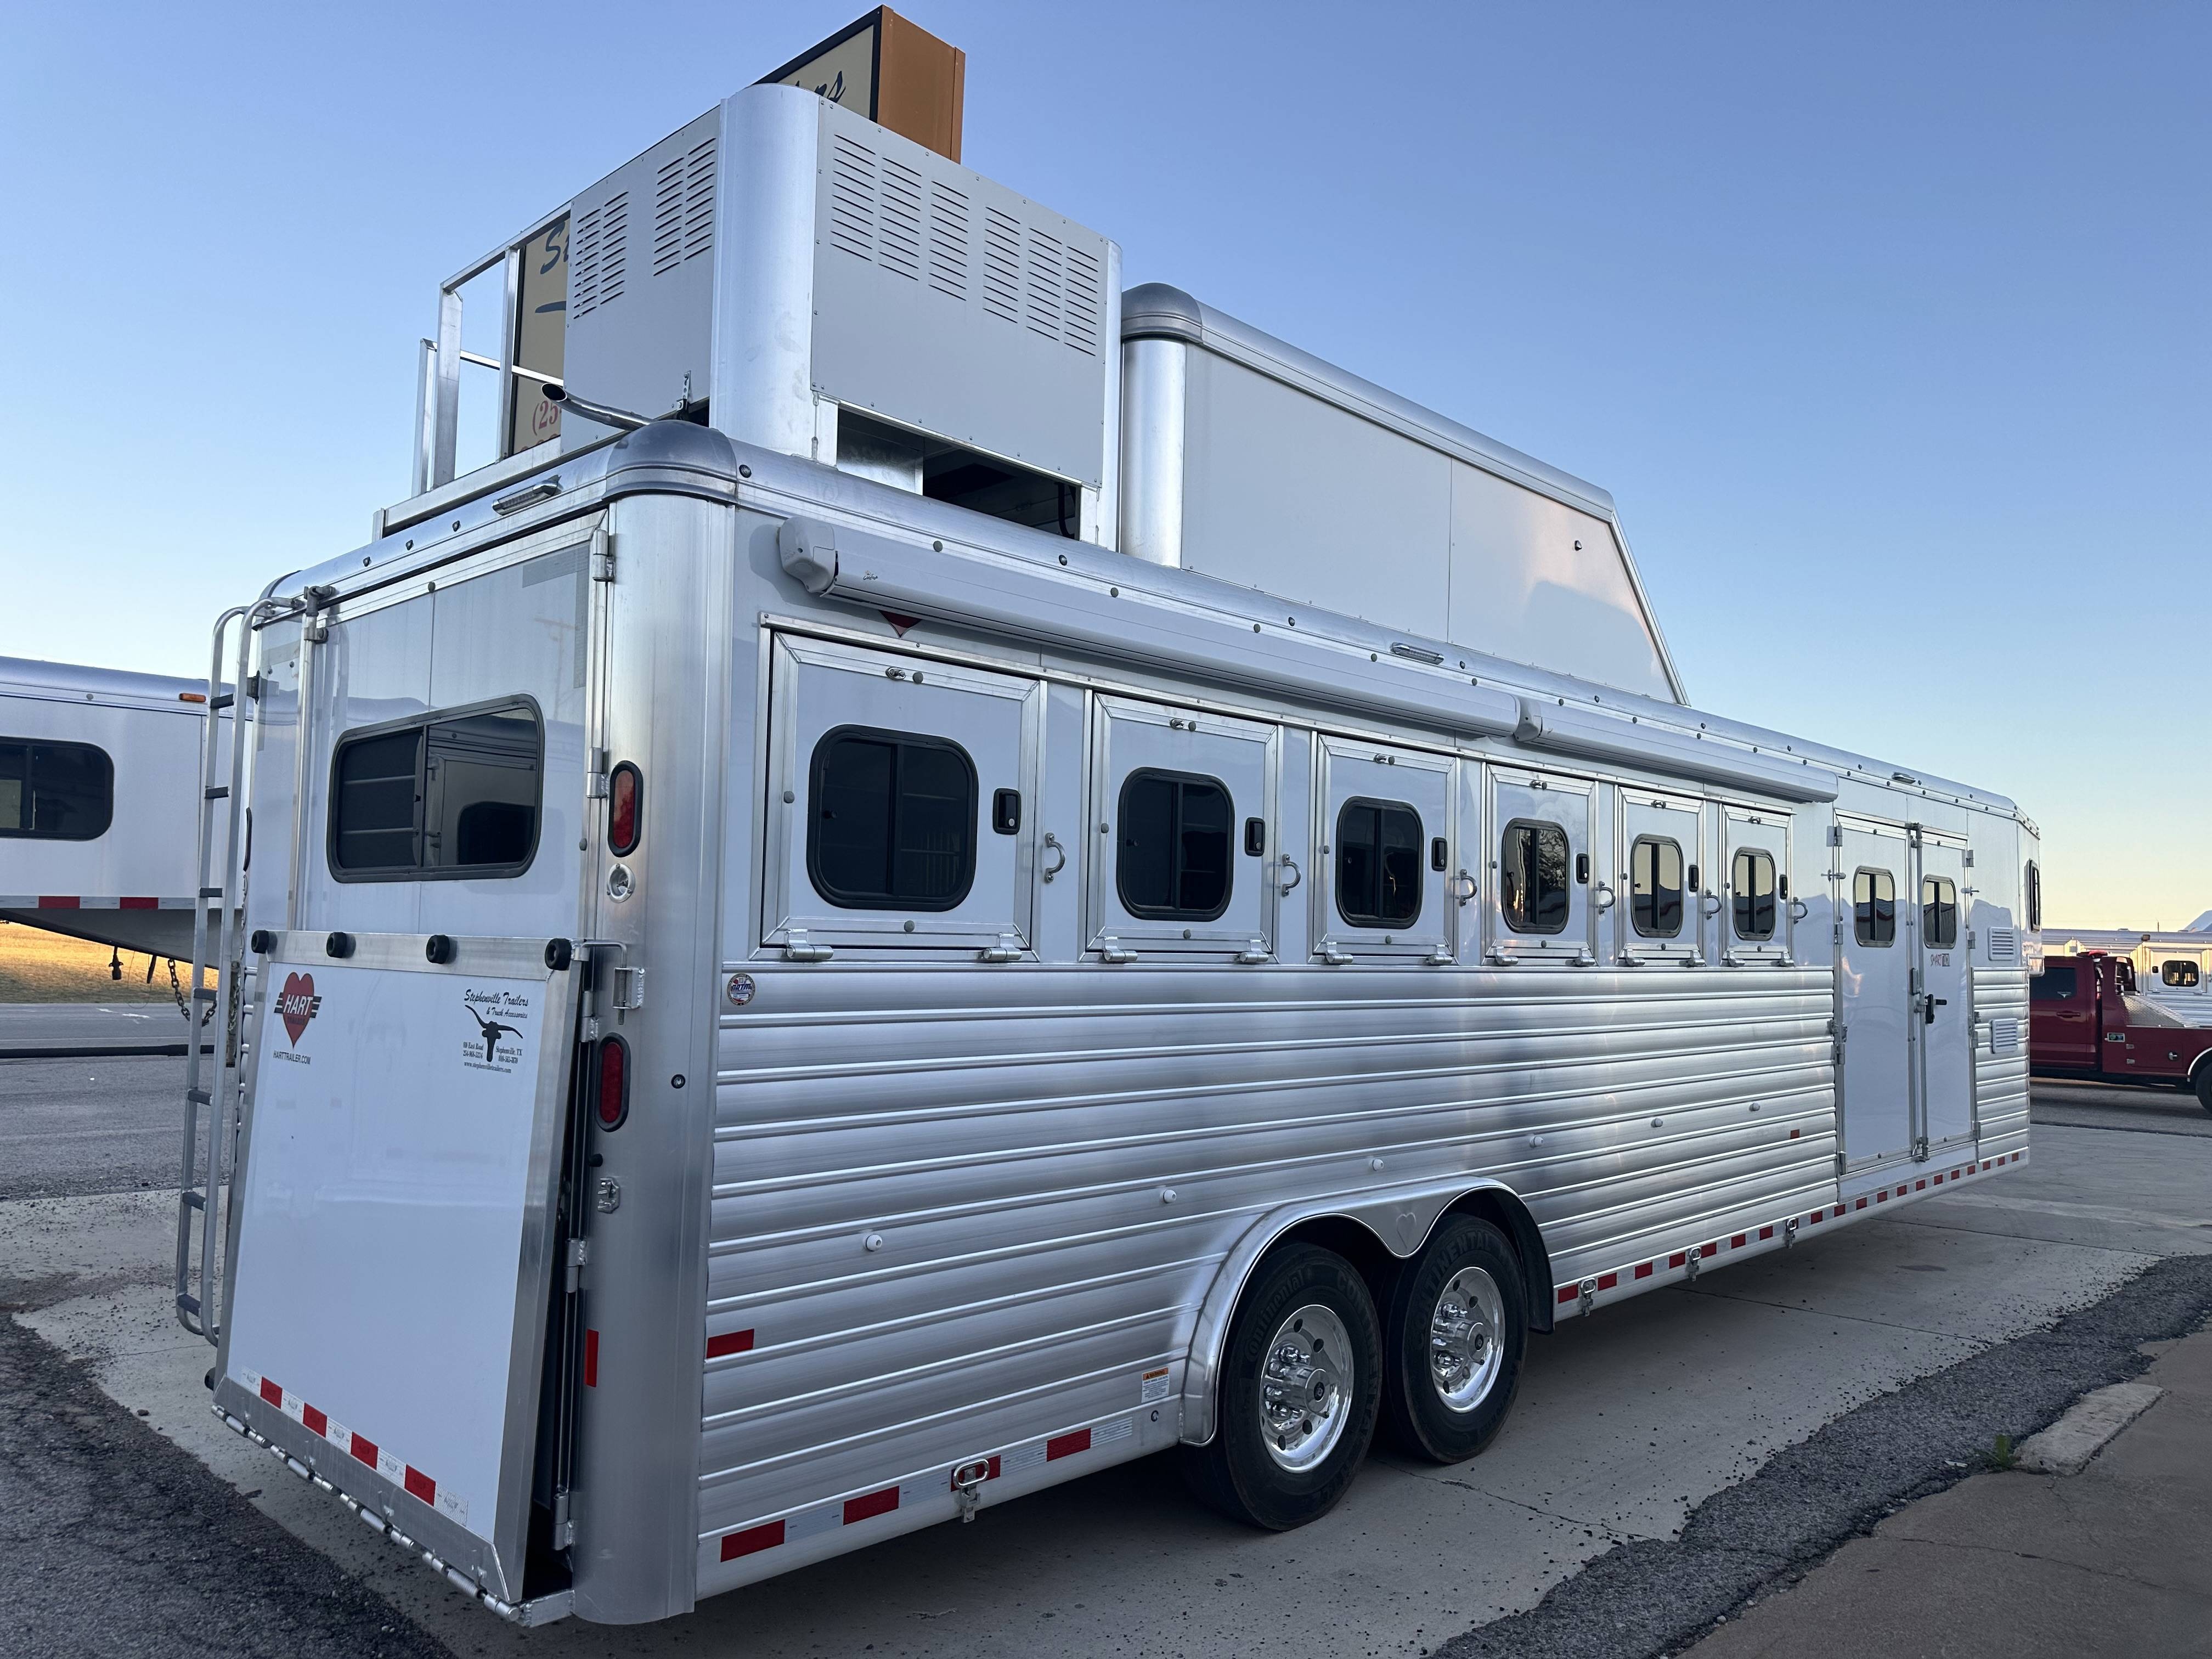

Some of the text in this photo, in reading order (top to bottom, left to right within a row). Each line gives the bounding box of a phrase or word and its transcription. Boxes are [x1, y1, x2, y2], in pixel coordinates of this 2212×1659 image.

[283, 994, 314, 1015] HART
[464, 989, 529, 1007] Stephenville Trailers
[492, 1007, 504, 1017] Truck
[273, 1050, 311, 1064] HARTTRAILER.COM
